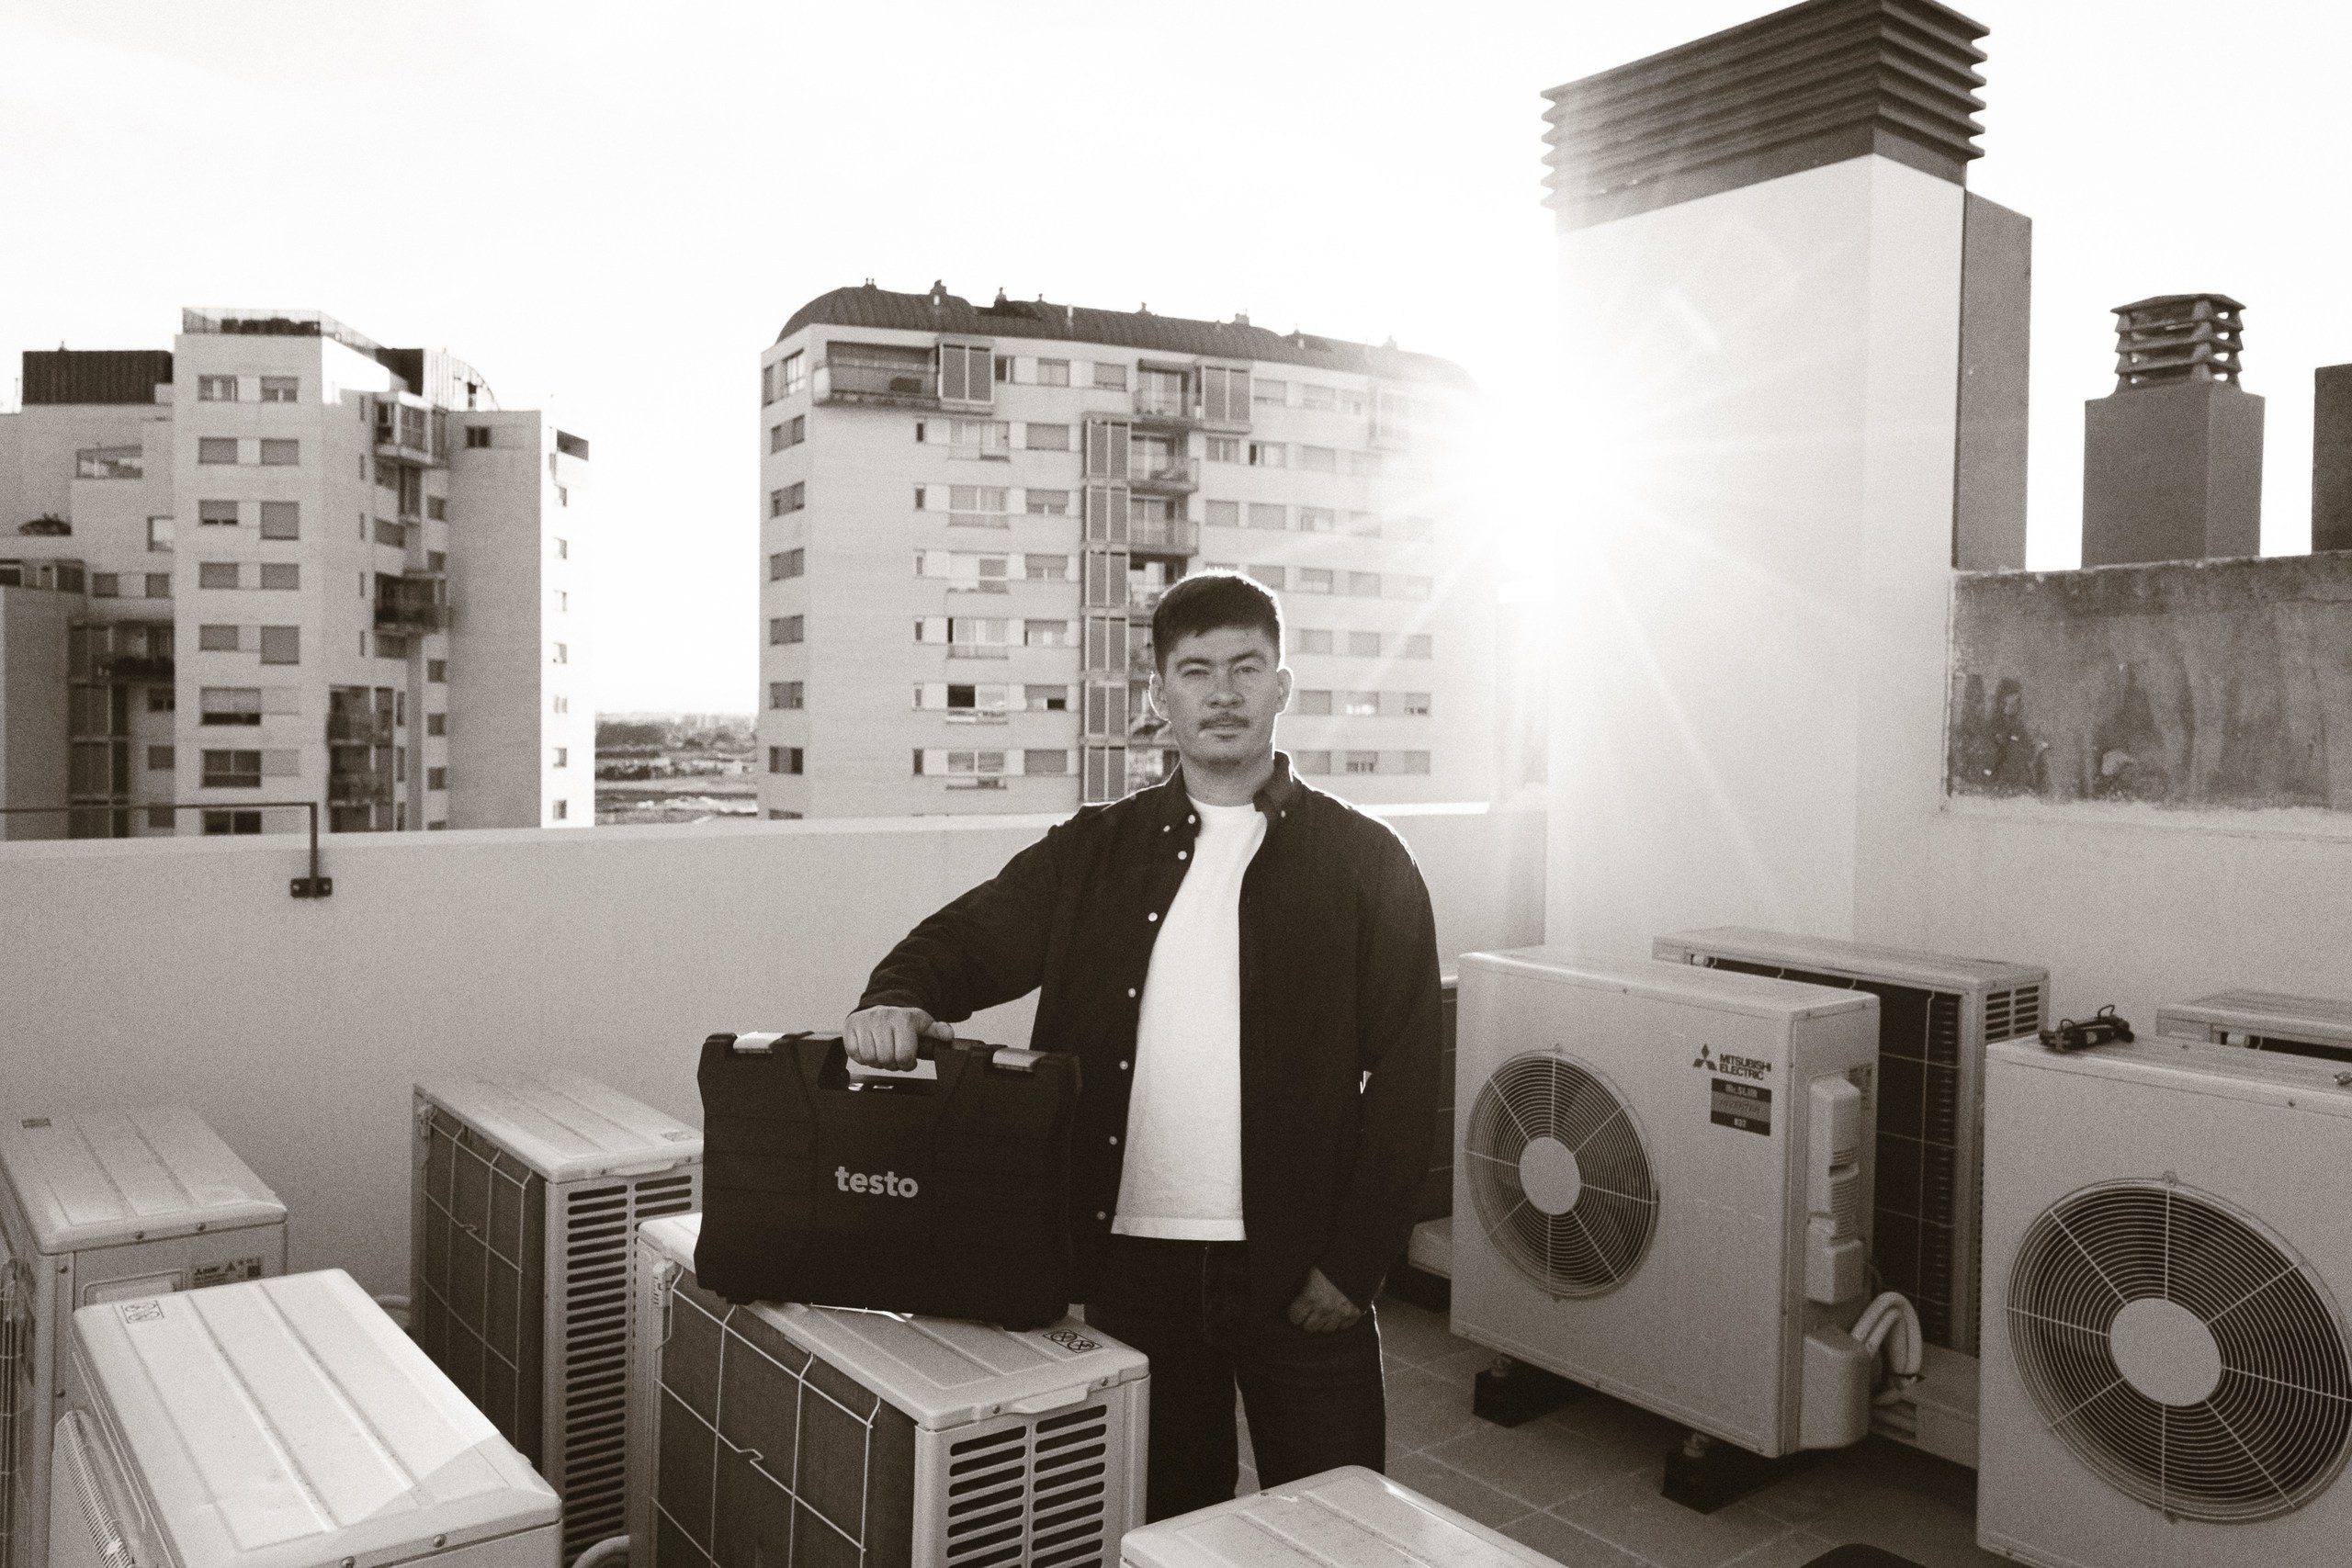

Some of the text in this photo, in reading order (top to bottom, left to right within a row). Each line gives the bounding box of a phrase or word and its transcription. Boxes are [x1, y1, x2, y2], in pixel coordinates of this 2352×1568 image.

[1719, 1054, 1771, 1072] MITSUBISHI
[1719, 1063, 1764, 1080] ELECTRIC
[834, 1166, 919, 1198] testo
